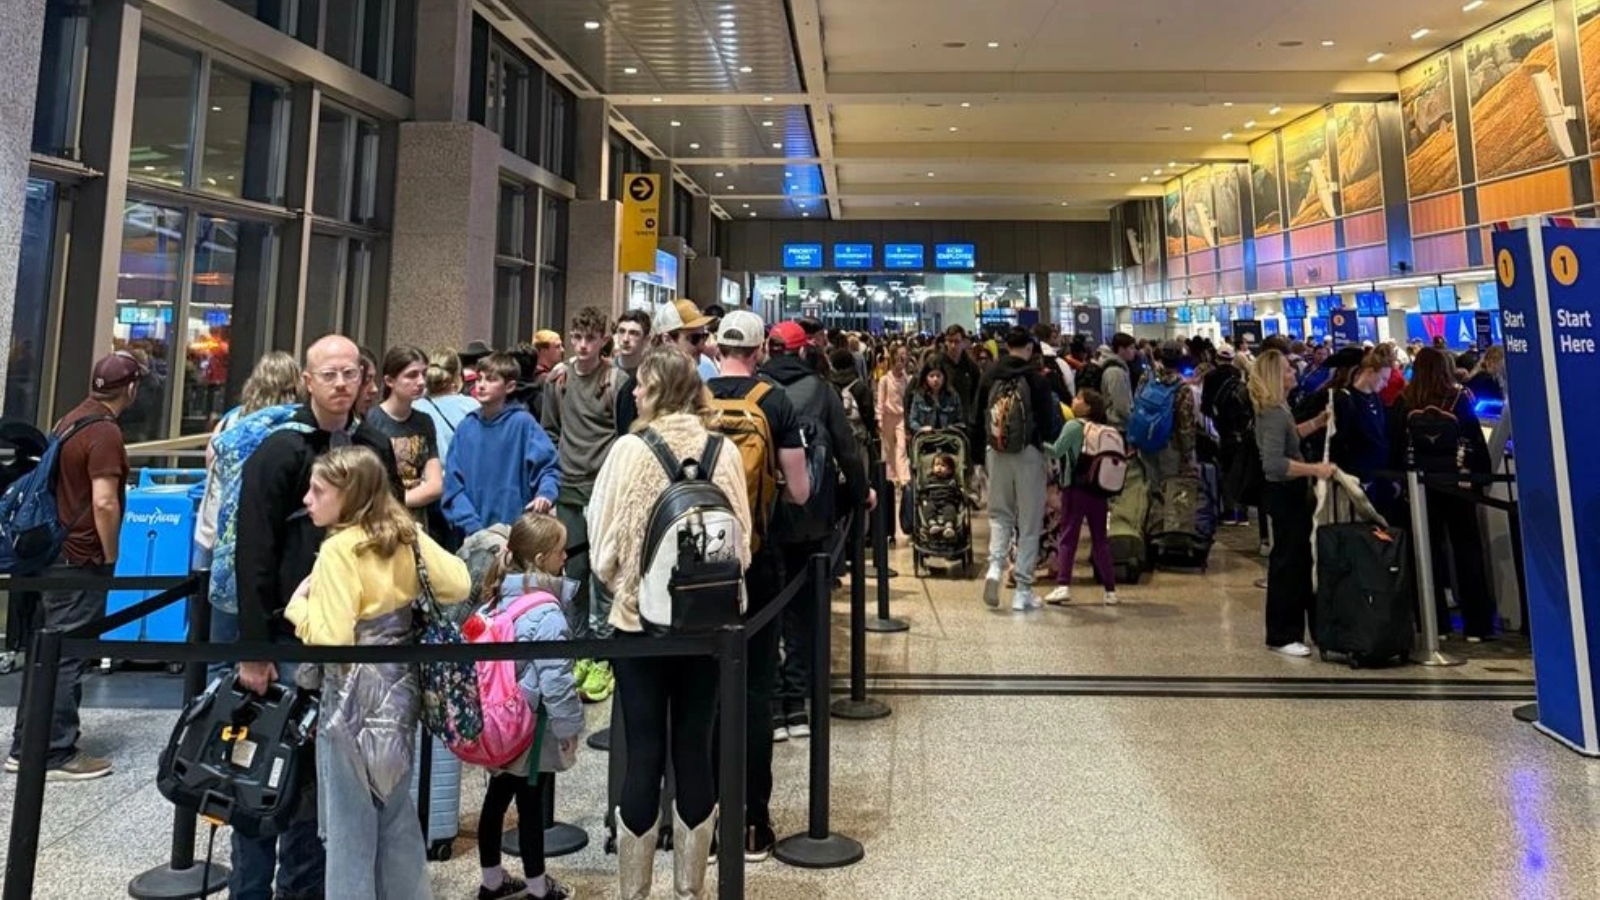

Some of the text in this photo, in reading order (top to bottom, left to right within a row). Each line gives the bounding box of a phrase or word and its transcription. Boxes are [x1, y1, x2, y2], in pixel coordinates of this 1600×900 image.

[1502, 258, 1509, 278] 1
[1559, 255, 1568, 276] 1
[1503, 310, 1526, 328] Start
[1557, 308, 1592, 328] Start
[1506, 334, 1528, 353] Here
[1560, 334, 1595, 353] Here
